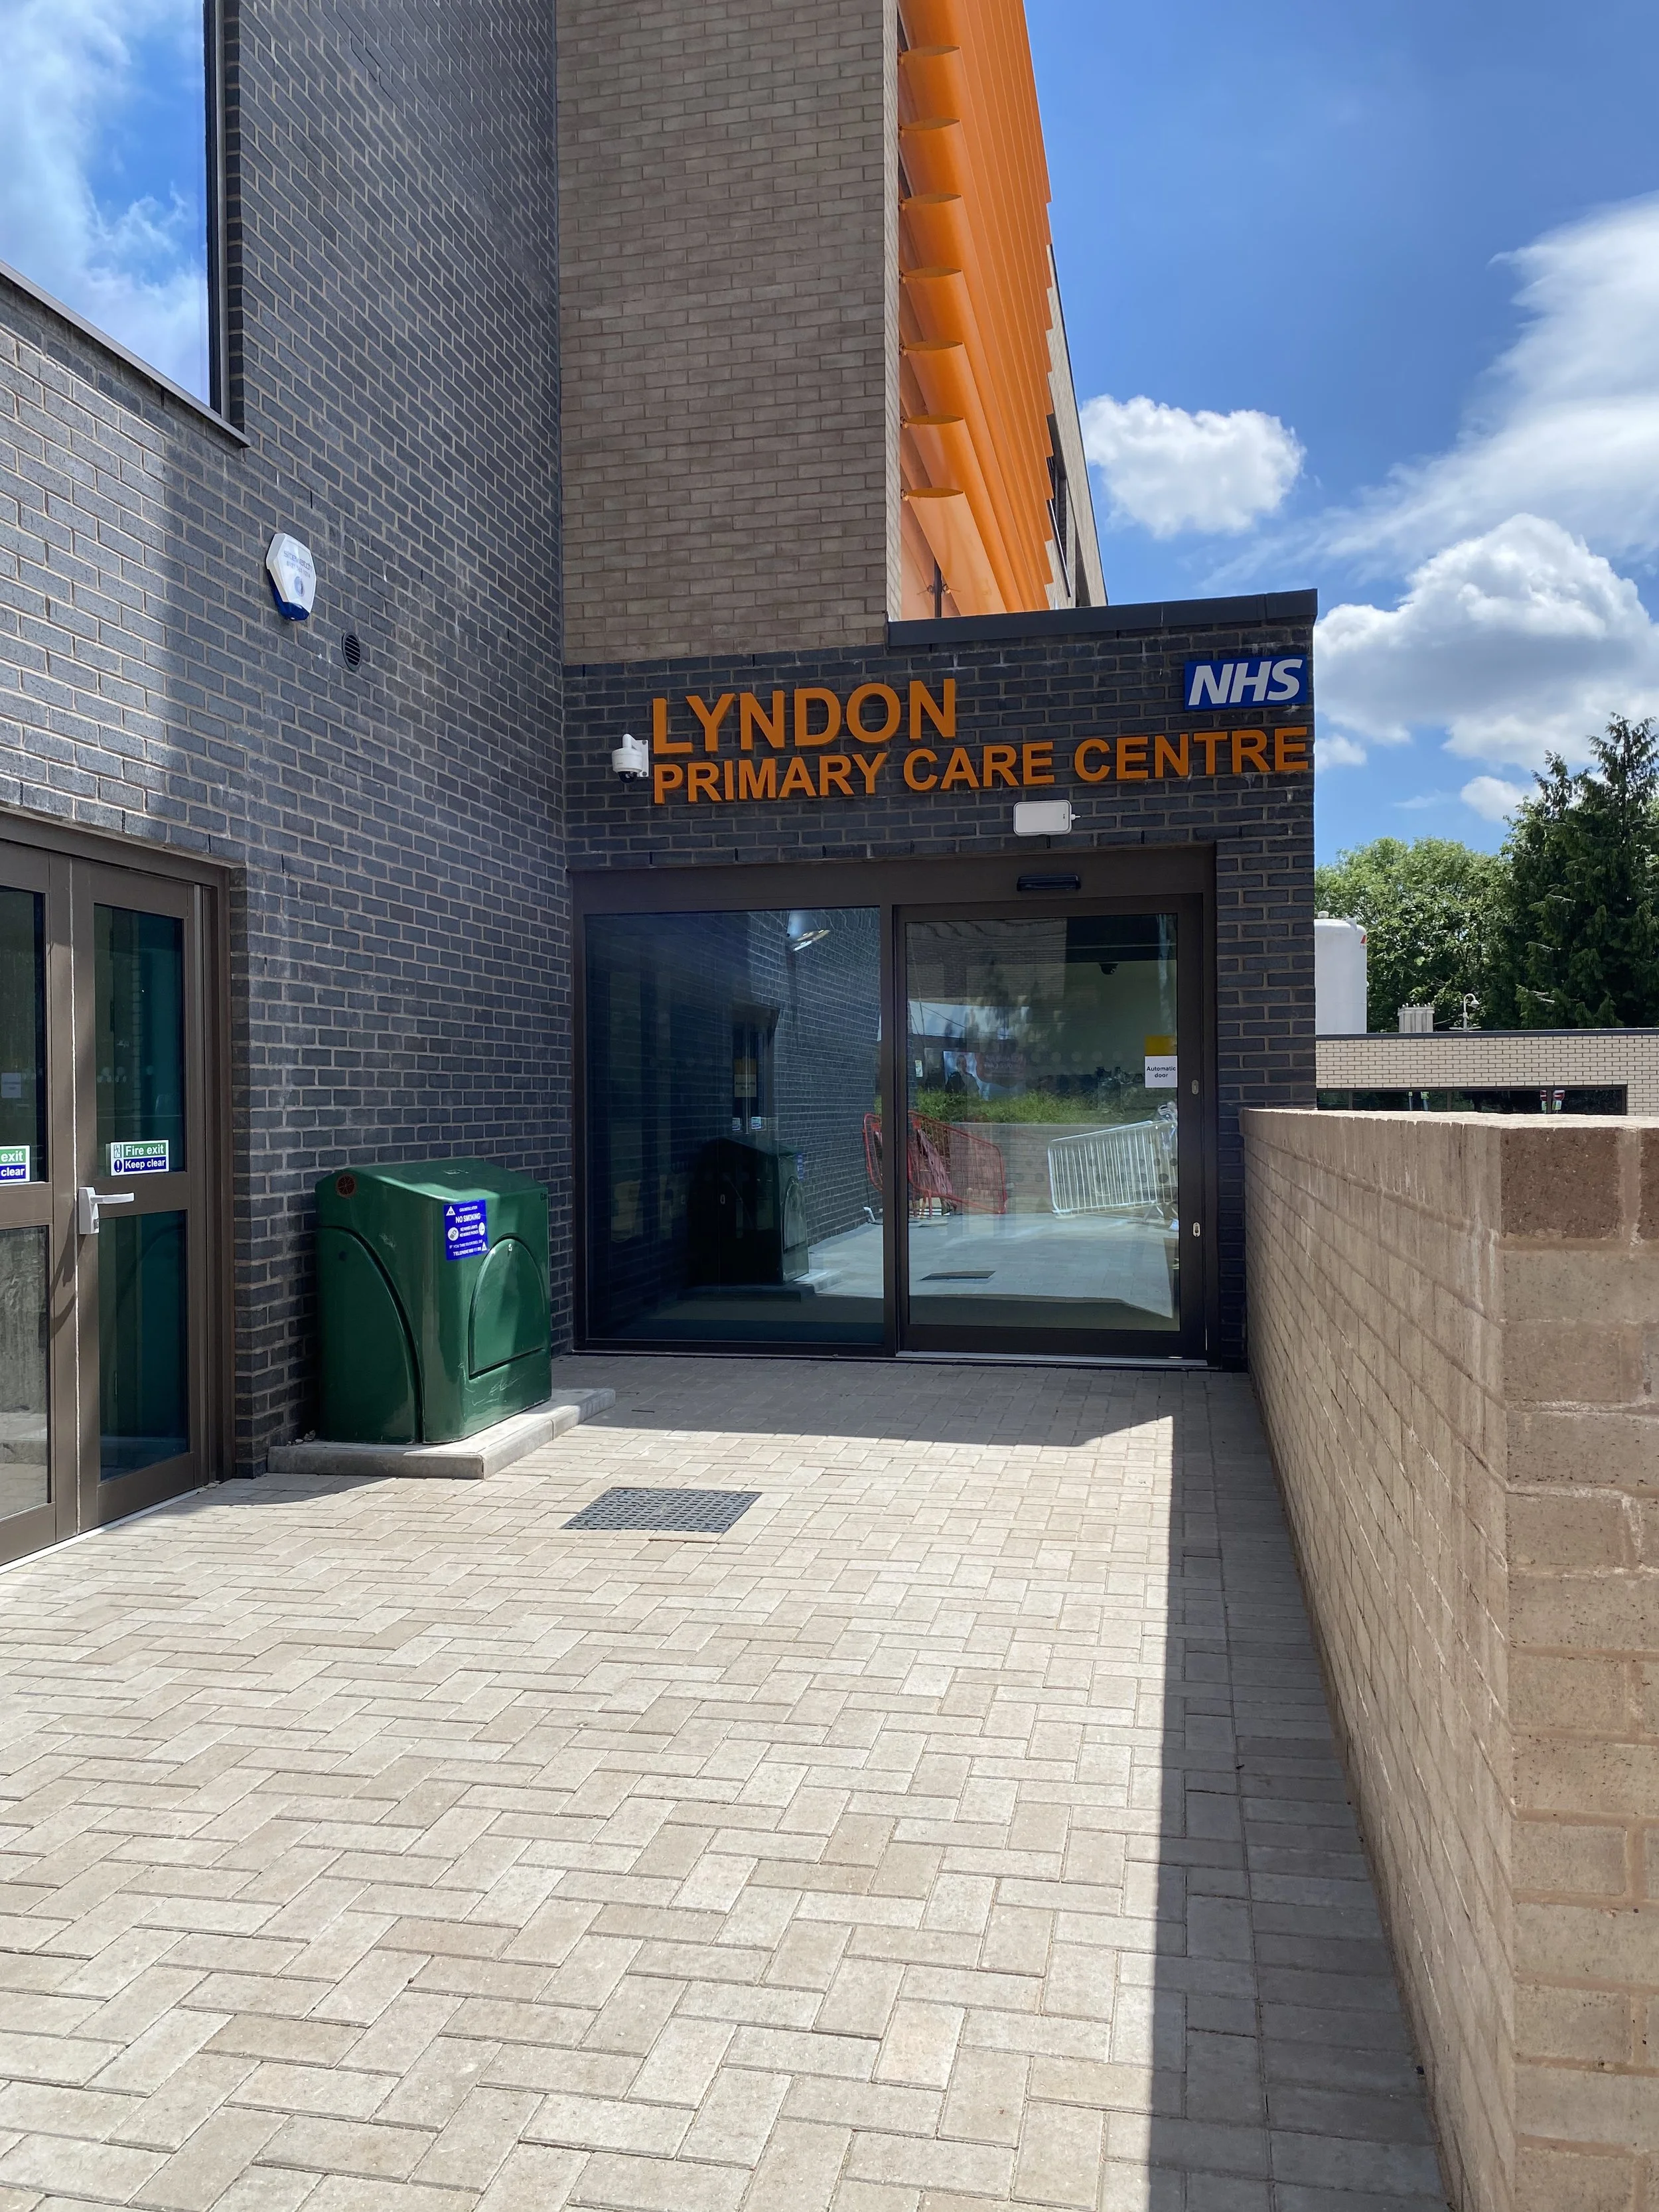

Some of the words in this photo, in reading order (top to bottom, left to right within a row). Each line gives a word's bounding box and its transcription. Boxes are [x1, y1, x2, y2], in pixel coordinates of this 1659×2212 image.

[1188, 658, 1303, 707] NHS
[652, 678, 956, 755] LYNDON
[653, 752, 888, 805] PRIMARY
[903, 741, 1055, 792] CARE
[1074, 727, 1309, 782] CENTRE
[125, 1145, 145, 1156] Fire
[147, 1143, 165, 1155] exit
[1, 1150, 24, 1162] exit
[125, 1159, 145, 1170] Keep
[147, 1159, 166, 1167] clear
[1, 1166, 25, 1177] clear
[463, 1213, 481, 1222] SMOKING
